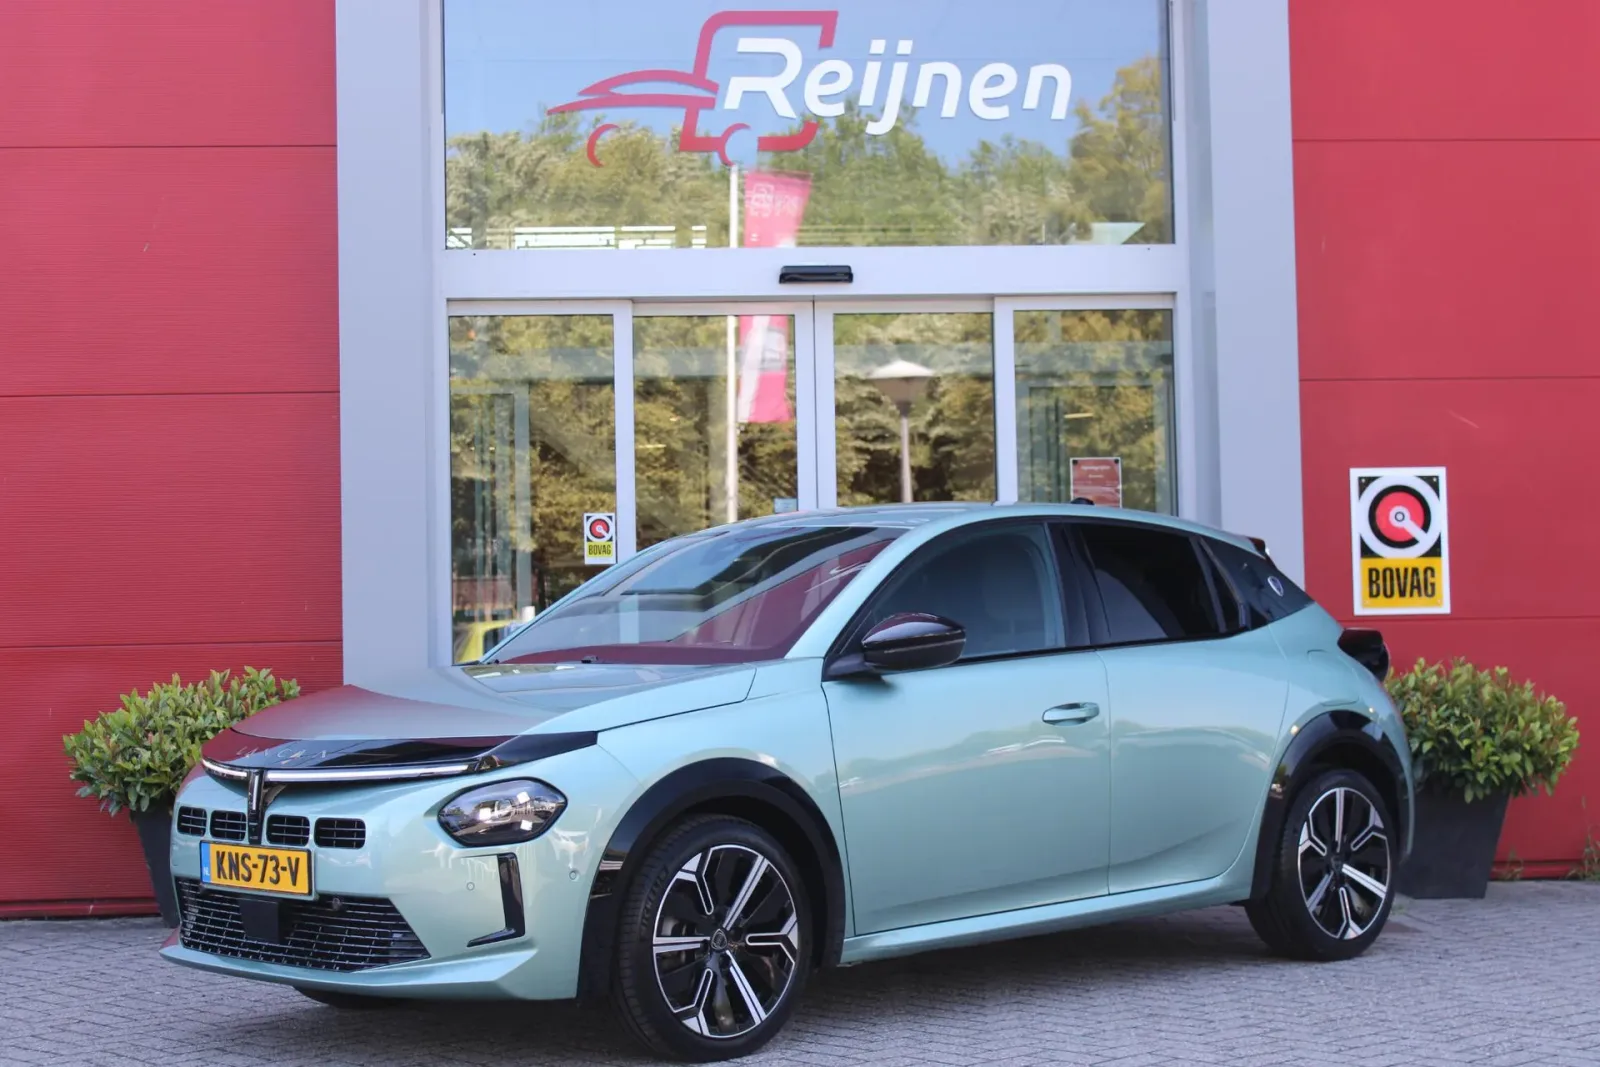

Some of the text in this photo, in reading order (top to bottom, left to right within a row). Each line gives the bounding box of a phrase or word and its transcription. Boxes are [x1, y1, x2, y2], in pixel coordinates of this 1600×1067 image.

[723, 37, 1073, 136] Reijnen
[588, 544, 611, 555] BOVAG
[1368, 566, 1436, 599] BOVAG
[216, 851, 300, 886] KNS-73-V
